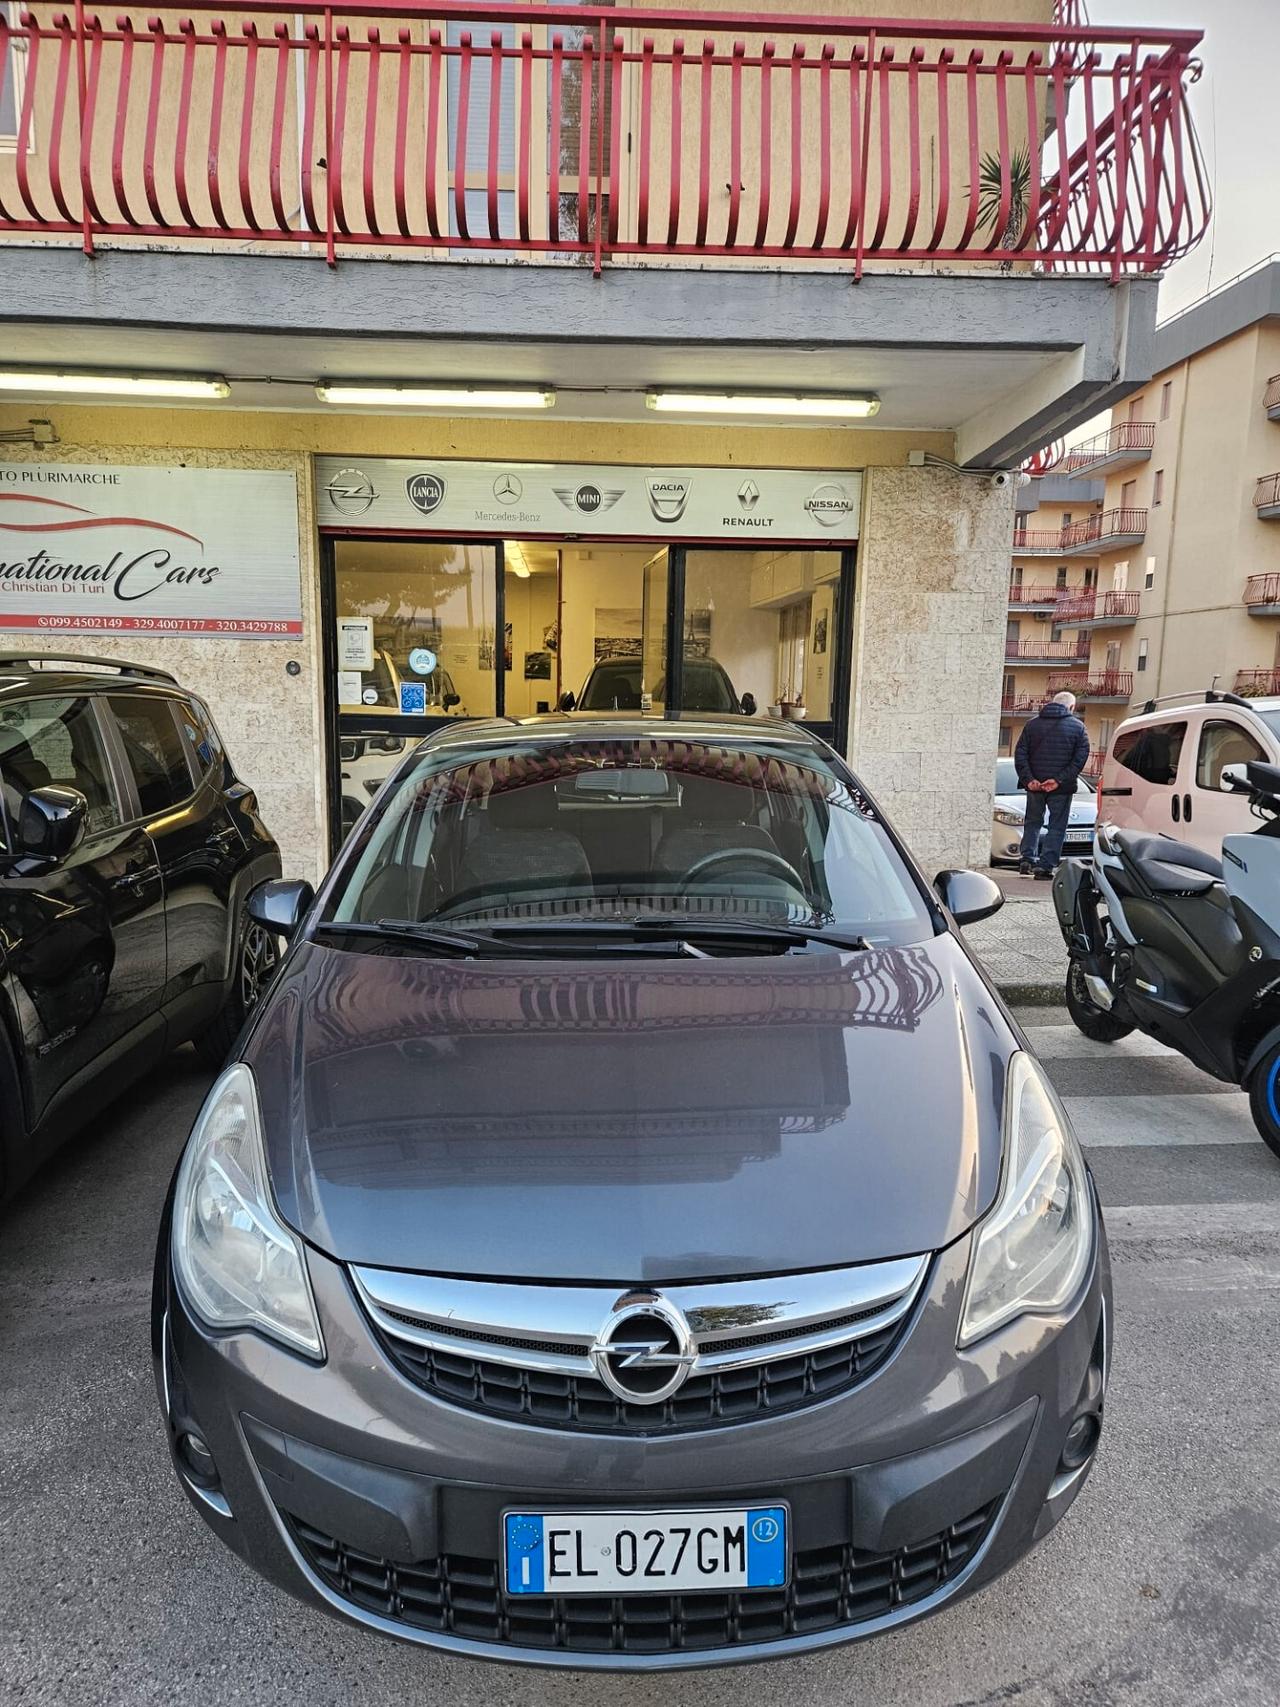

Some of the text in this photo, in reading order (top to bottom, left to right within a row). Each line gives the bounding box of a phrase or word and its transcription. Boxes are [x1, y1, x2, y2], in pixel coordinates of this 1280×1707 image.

[22, 471, 121, 485] PLURIMARCHE
[413, 486, 439, 498] LANCIA
[652, 483, 685, 491] DACIA
[577, 494, 600, 504] MINI
[808, 500, 849, 509] NISSAN
[474, 511, 541, 523] Mercedes-Benz
[722, 517, 774, 527] RENAULT
[113, 549, 222, 601] Cars
[2, 581, 105, 594] Christian Di Turi
[49, 617, 122, 628] 099.4502149
[133, 619, 205, 630] 329.4007177
[216, 620, 288, 631] 320.3429788
[548, 1525, 746, 1577] EL 027GM
